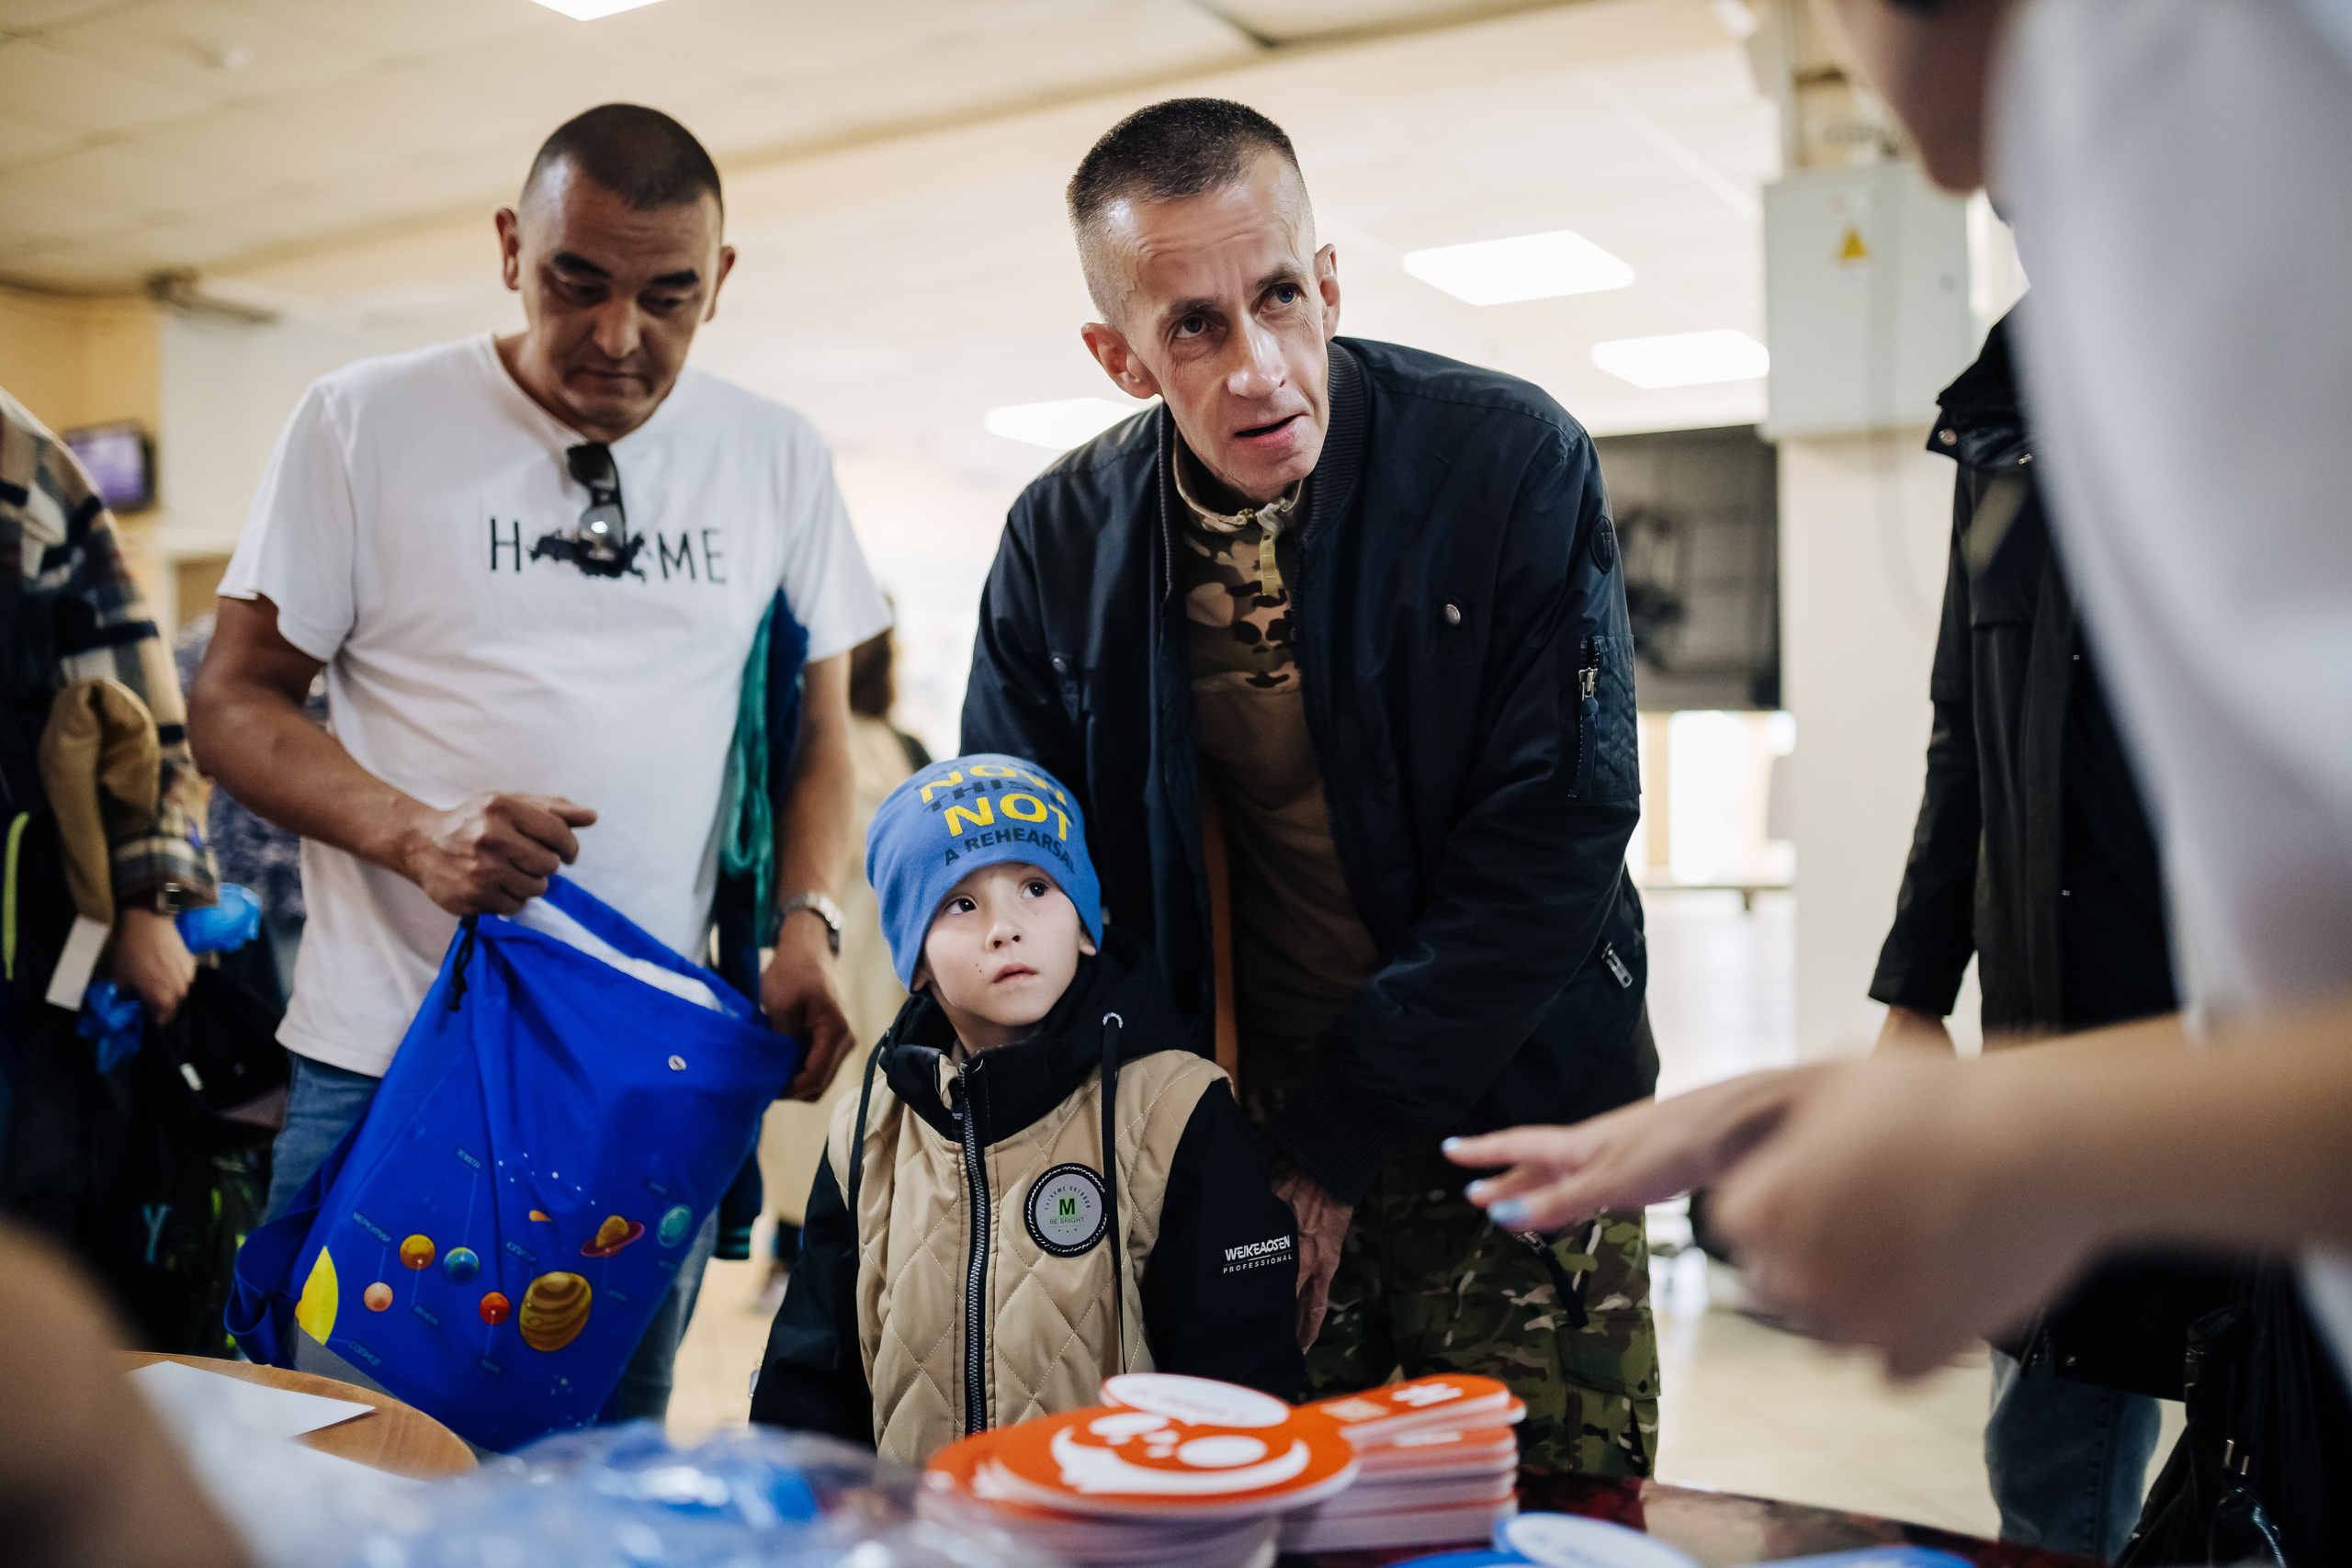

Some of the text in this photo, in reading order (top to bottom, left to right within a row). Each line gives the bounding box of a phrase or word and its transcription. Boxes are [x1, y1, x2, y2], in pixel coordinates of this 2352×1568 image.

[944, 793, 1072, 841] NOT
[944, 849, 960, 866] A
[1059, 1198, 1076, 1215] M
[1059, 1216, 1085, 1224] BRIGHT
[1223, 1254, 1293, 1274] PROFESSIONAL
